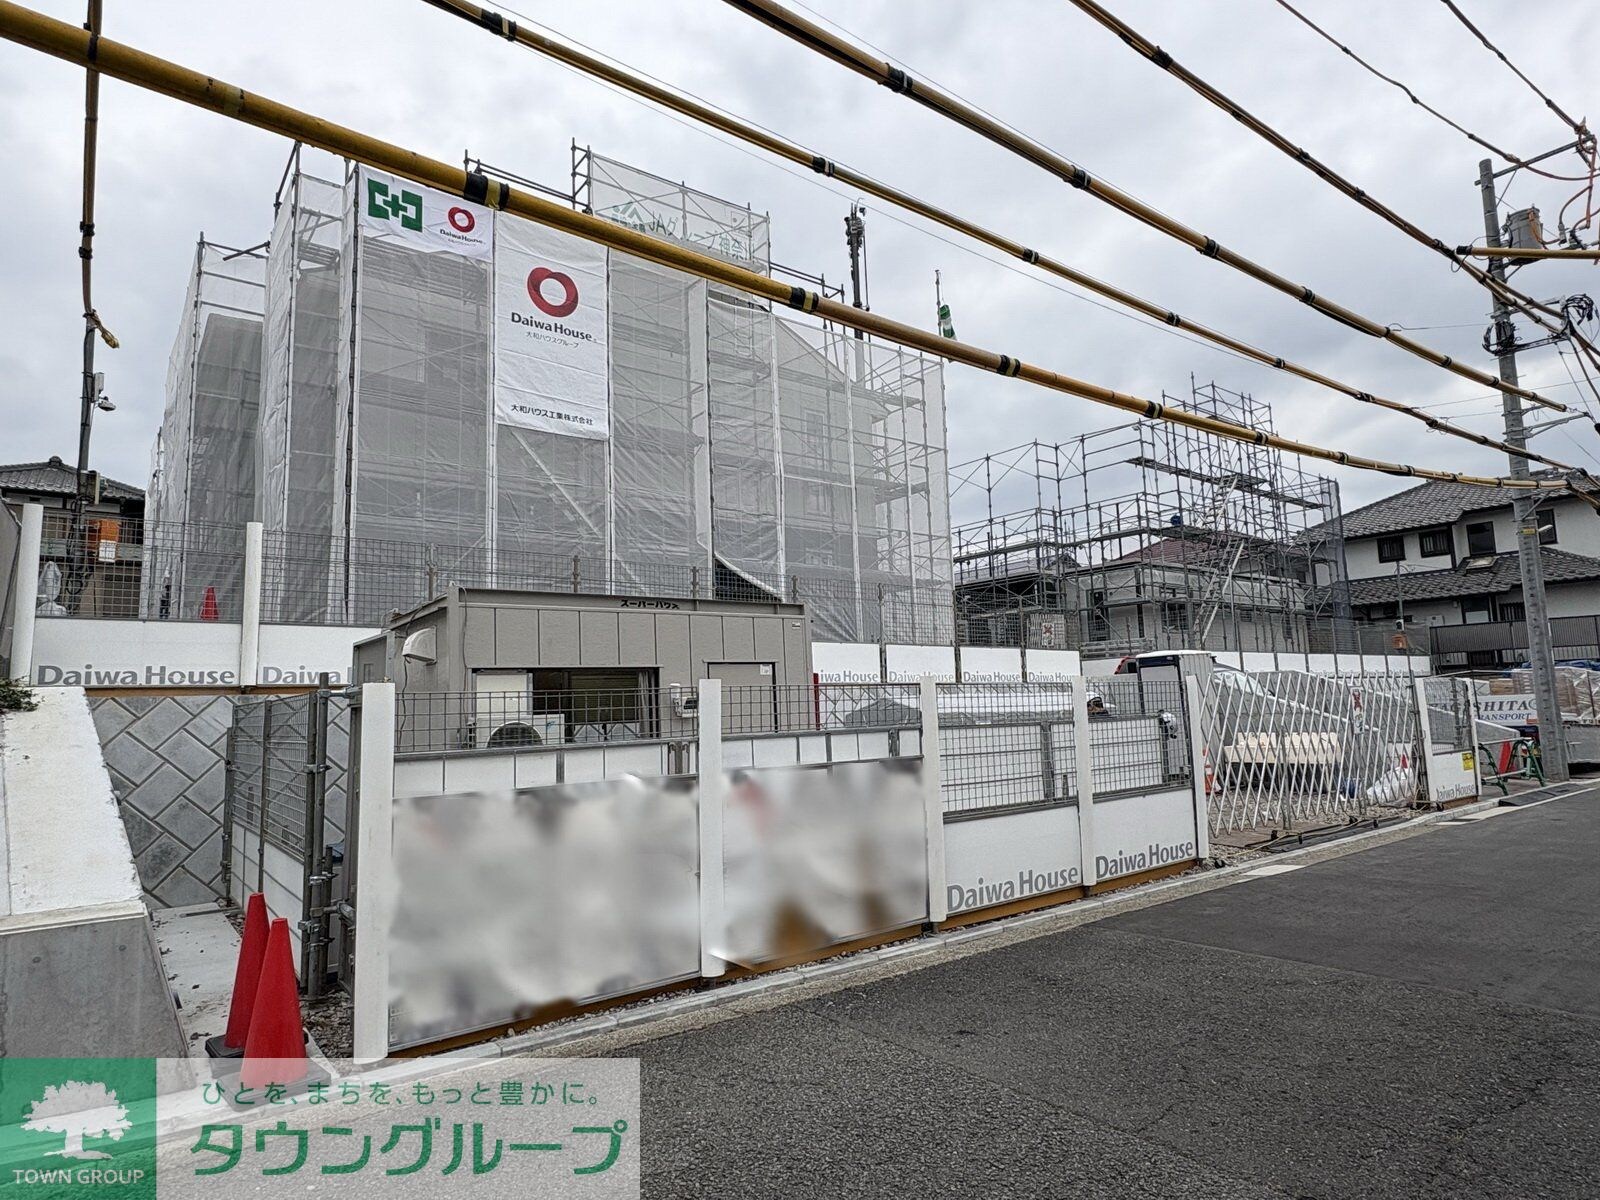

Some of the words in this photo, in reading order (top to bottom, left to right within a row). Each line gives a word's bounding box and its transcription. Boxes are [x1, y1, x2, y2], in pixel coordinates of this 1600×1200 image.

[511, 312, 552, 332] Daiwa
[554, 323, 593, 341] House
[526, 331, 579, 349] 大和ハウスグループ
[511, 404, 593, 425] 大和ハウス工業株式会社
[38, 664, 138, 686] Daiwa
[145, 665, 235, 685] House
[820, 669, 841, 682] iwa
[843, 670, 878, 682] House
[889, 670, 920, 682] Daiwa
[964, 671, 992, 682] Daiwa
[993, 672, 1021, 682] House
[1028, 671, 1054, 682] Daiwa
[1055, 672, 1072, 682] Hou
[1096, 850, 1146, 879] Daiwa
[1149, 841, 1193, 866] House
[946, 877, 1014, 912] Daiwa
[1019, 866, 1078, 896] House
